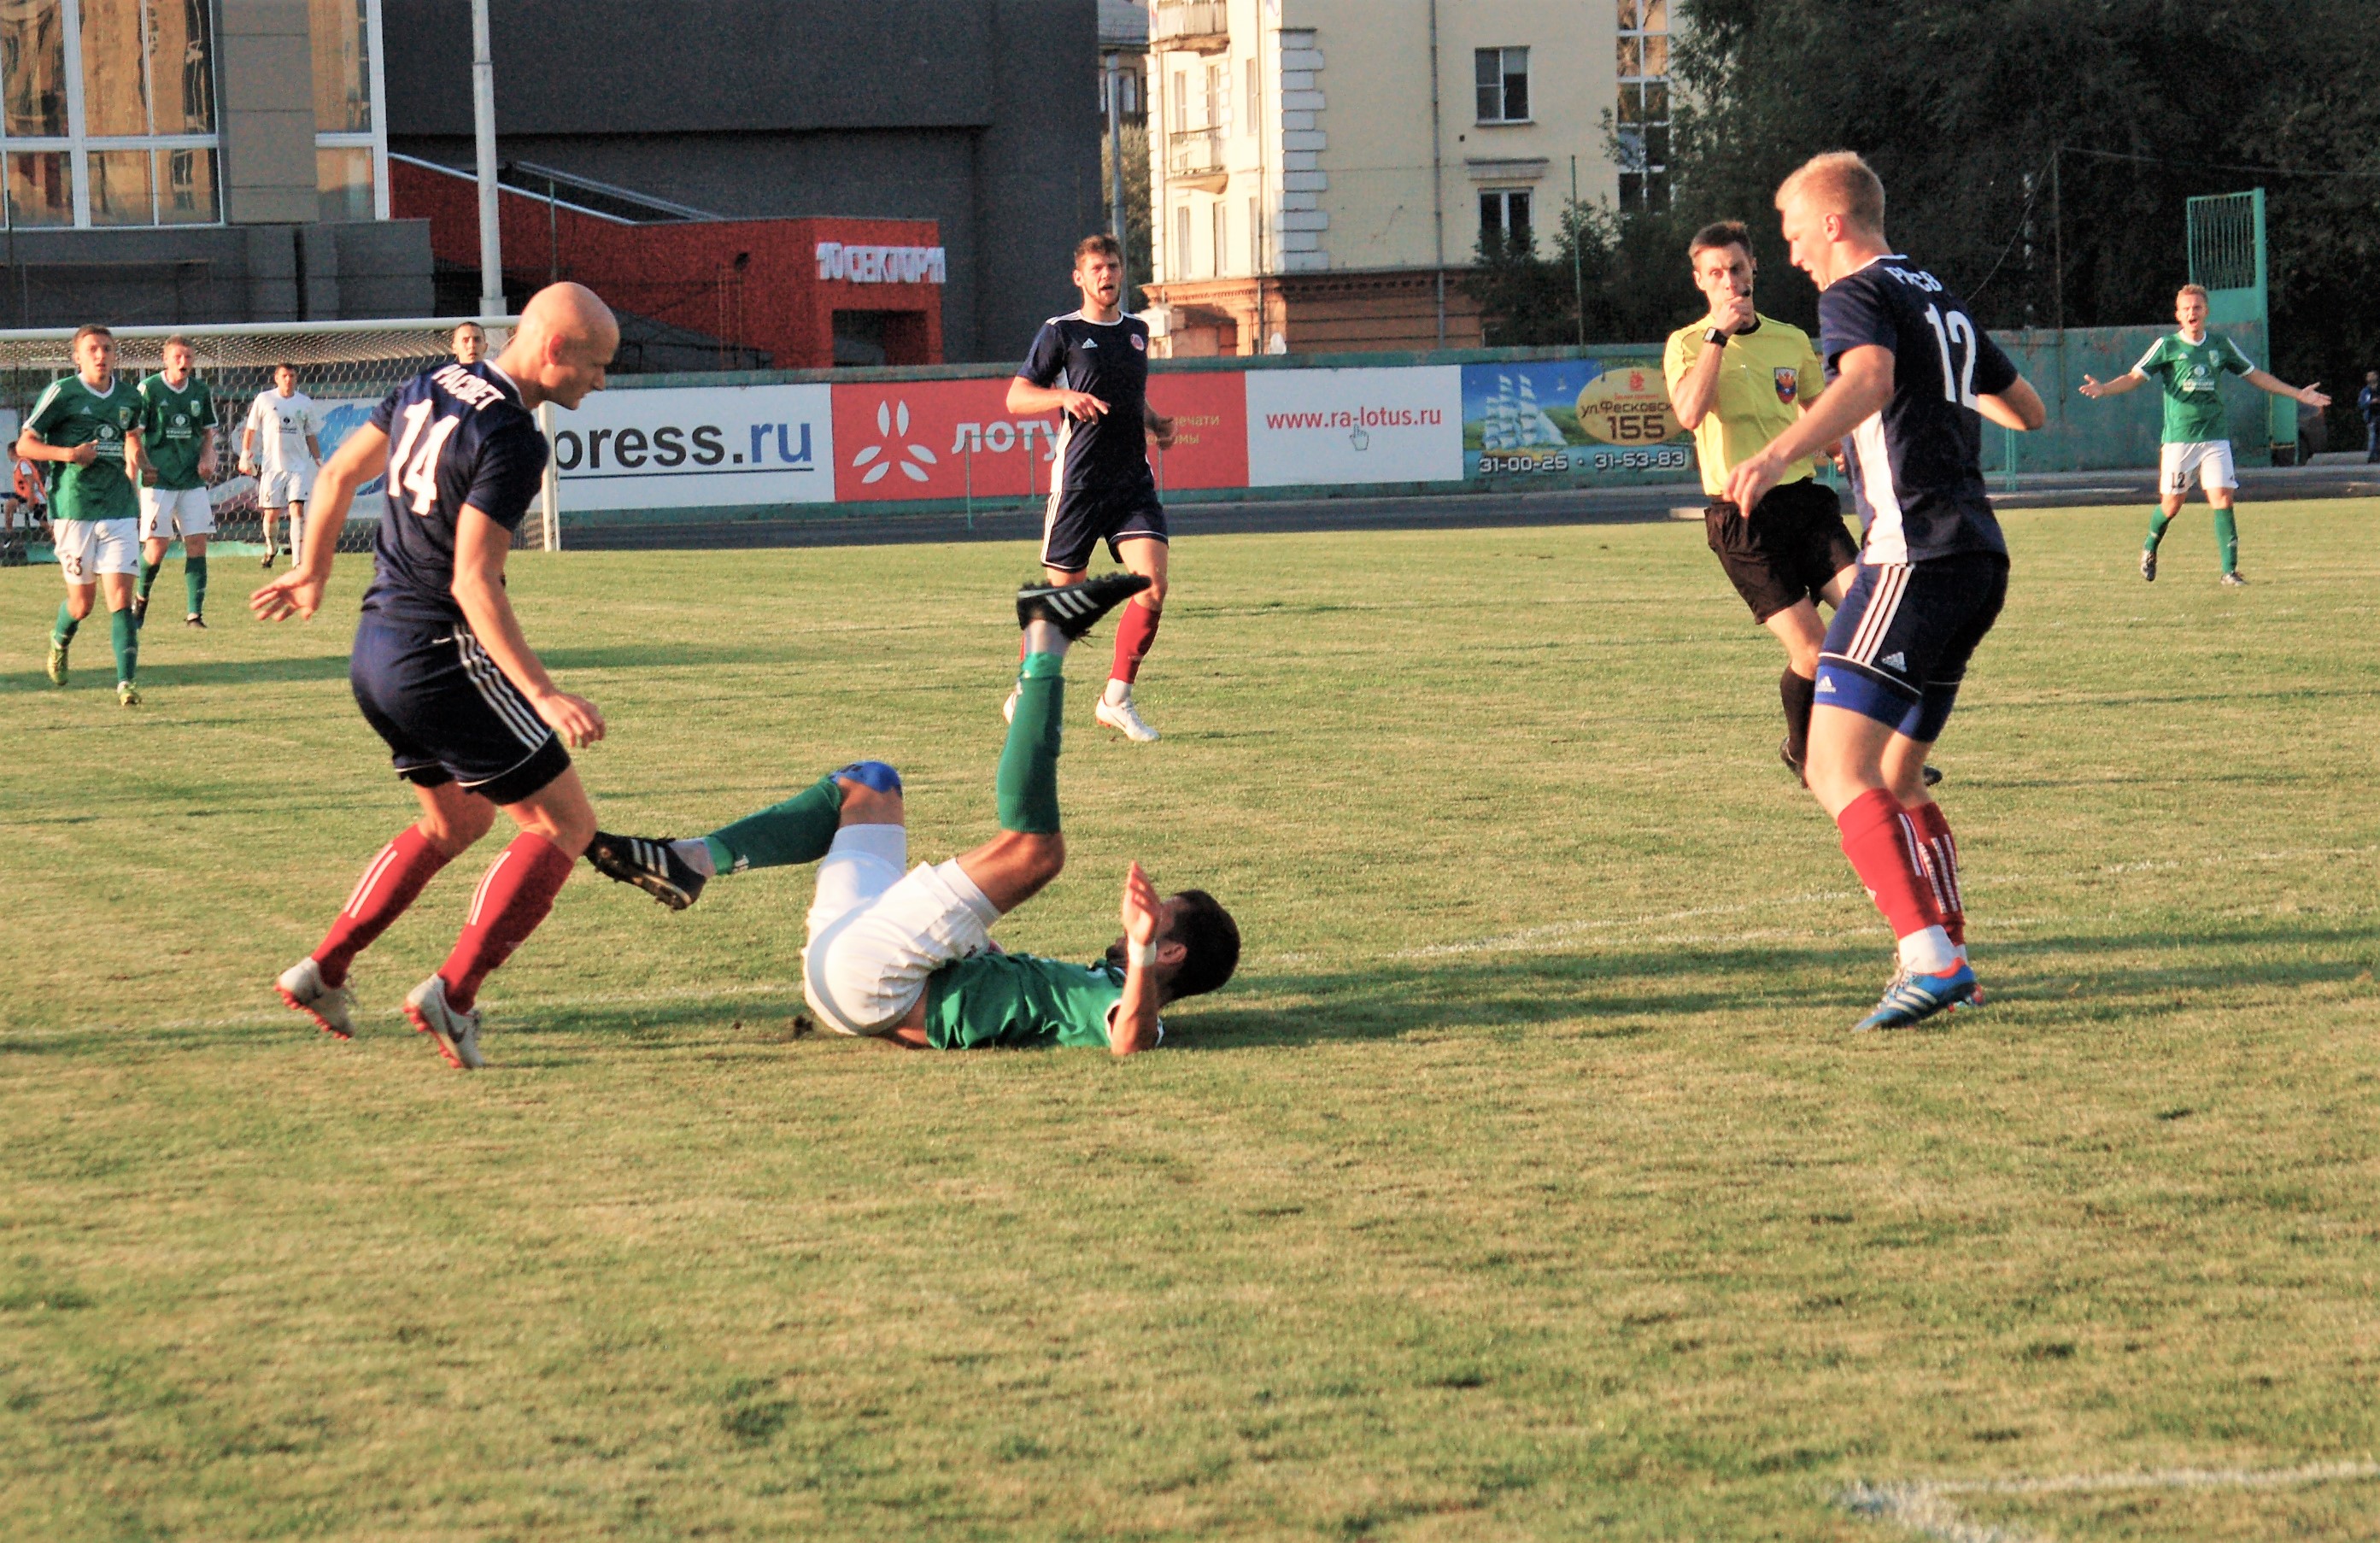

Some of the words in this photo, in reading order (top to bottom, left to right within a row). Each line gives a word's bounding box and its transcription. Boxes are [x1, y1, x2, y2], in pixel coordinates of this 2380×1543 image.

[1925, 302, 1979, 410] 12
[1266, 407, 1442, 429] www.ra-lotus.ru
[1607, 414, 1665, 439] 155
[389, 398, 460, 516] 14
[1595, 451, 1684, 468] 31-53-83
[2172, 472, 2185, 489] 12
[66, 554, 83, 576] 23
